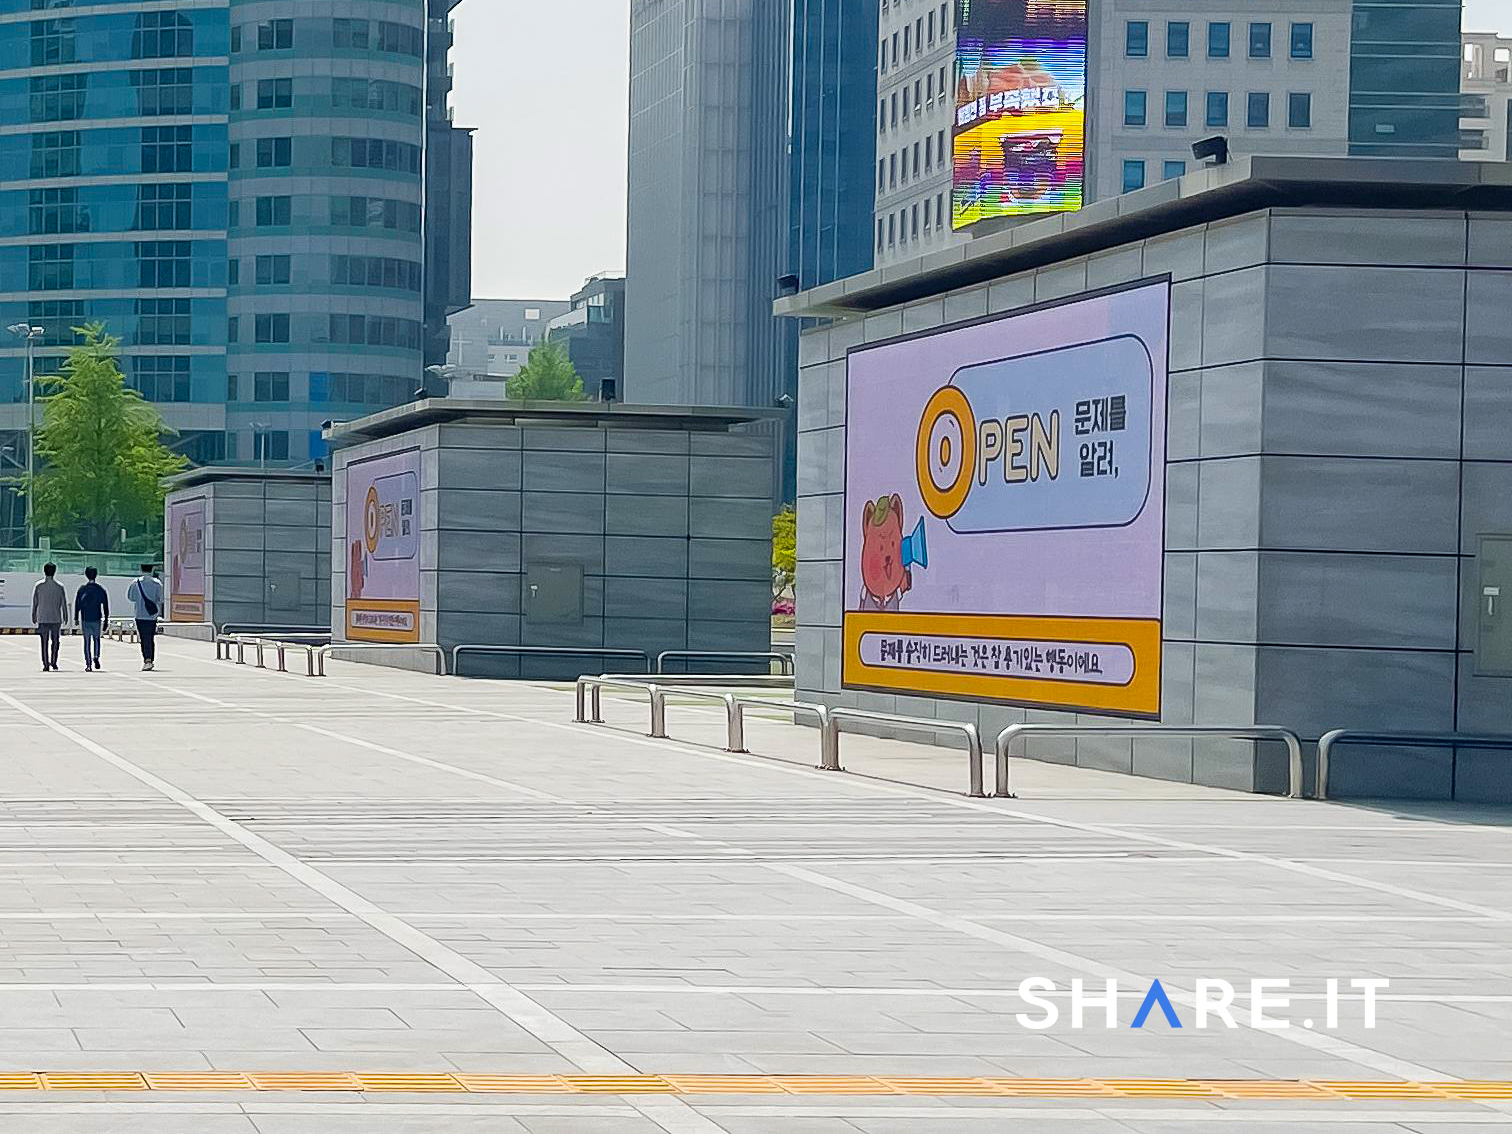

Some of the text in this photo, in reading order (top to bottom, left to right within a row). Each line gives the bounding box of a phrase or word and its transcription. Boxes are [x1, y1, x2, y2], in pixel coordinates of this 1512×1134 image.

[1073, 394, 1127, 436] 문제를
[916, 384, 1062, 520] OPEN
[1078, 440, 1120, 480] 알려,
